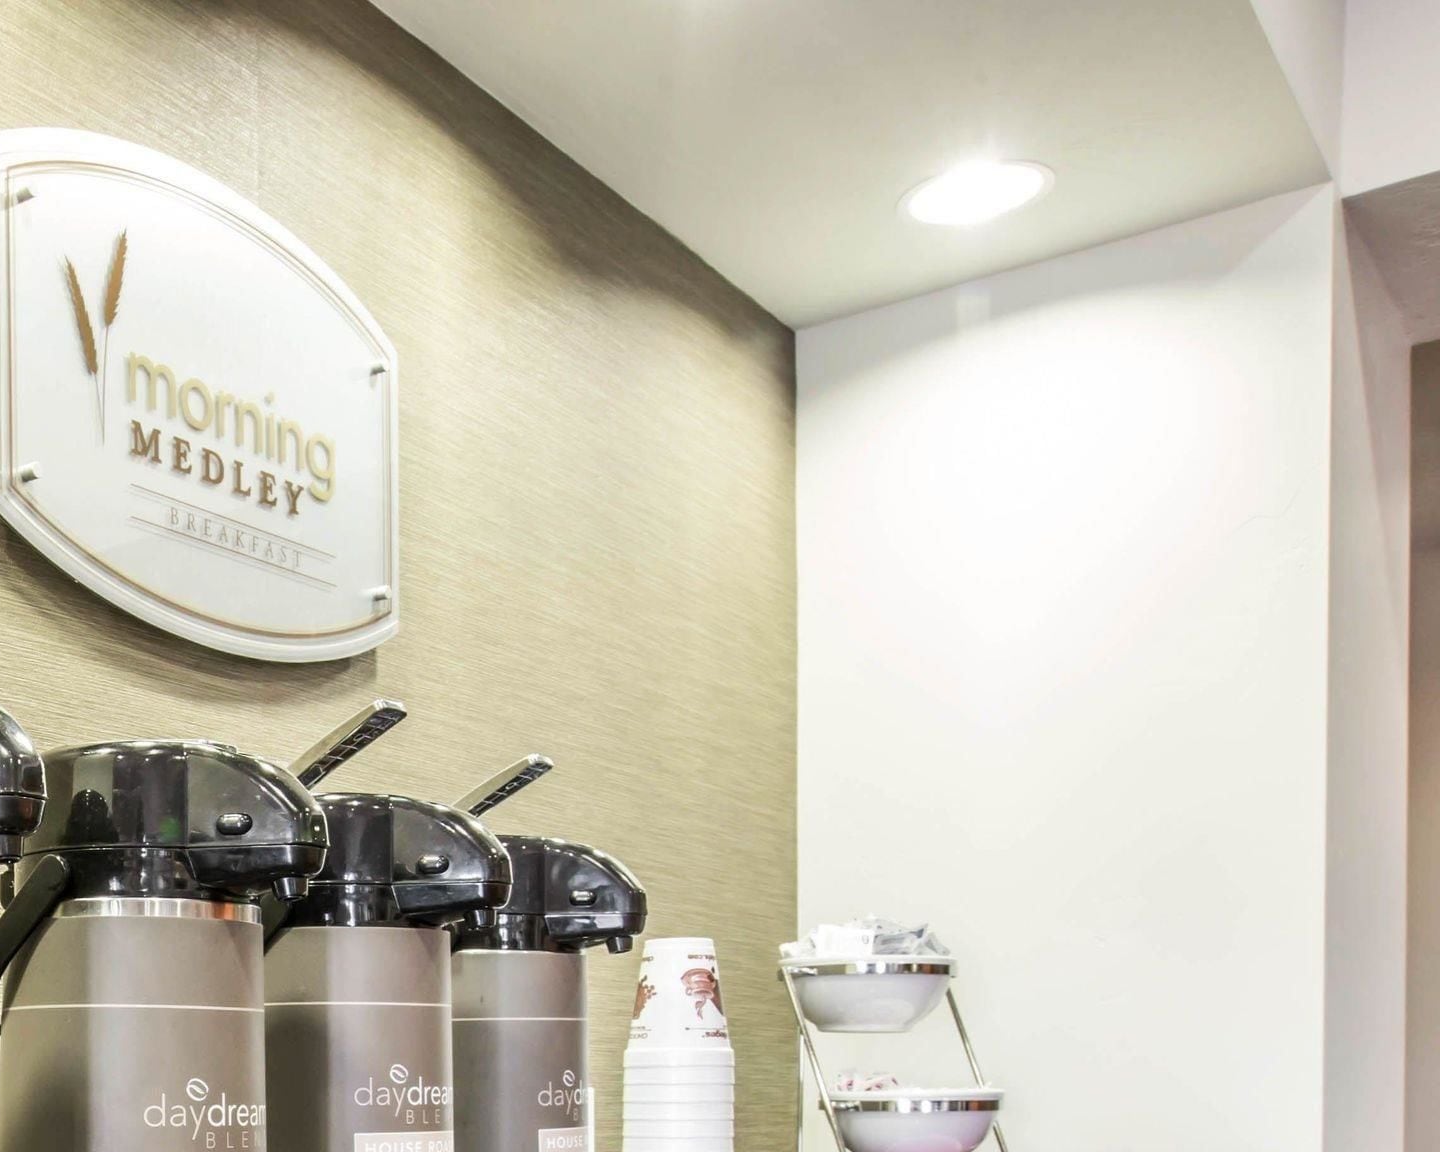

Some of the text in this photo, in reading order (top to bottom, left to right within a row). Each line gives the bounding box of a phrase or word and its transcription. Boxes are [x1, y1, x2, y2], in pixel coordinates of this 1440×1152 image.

[127, 350, 336, 502] morning
[130, 420, 305, 517] MEDLEY
[169, 507, 303, 568] BREAKFAST
[406, 1109, 441, 1124] BLE
[546, 1135, 583, 1149] HOUSE
